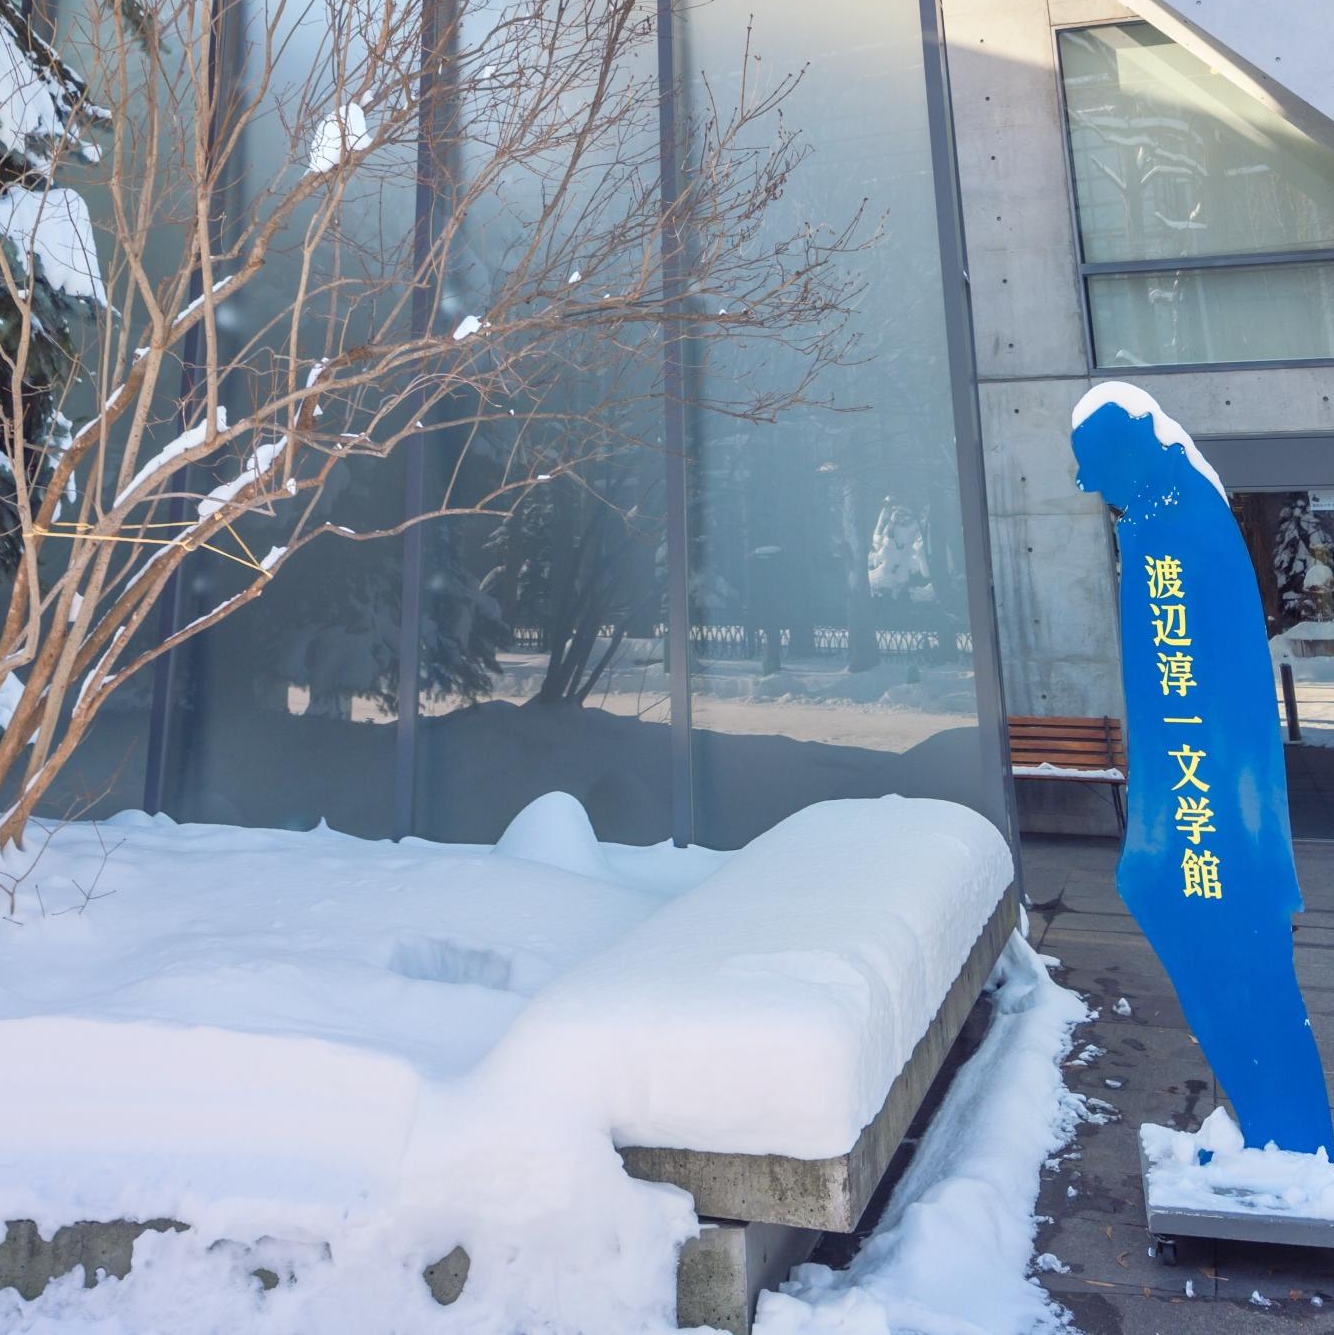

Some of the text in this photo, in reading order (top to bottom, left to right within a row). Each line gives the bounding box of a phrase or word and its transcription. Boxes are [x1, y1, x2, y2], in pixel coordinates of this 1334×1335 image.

[1144, 555, 1223, 900] 渡辺淳一文学館
